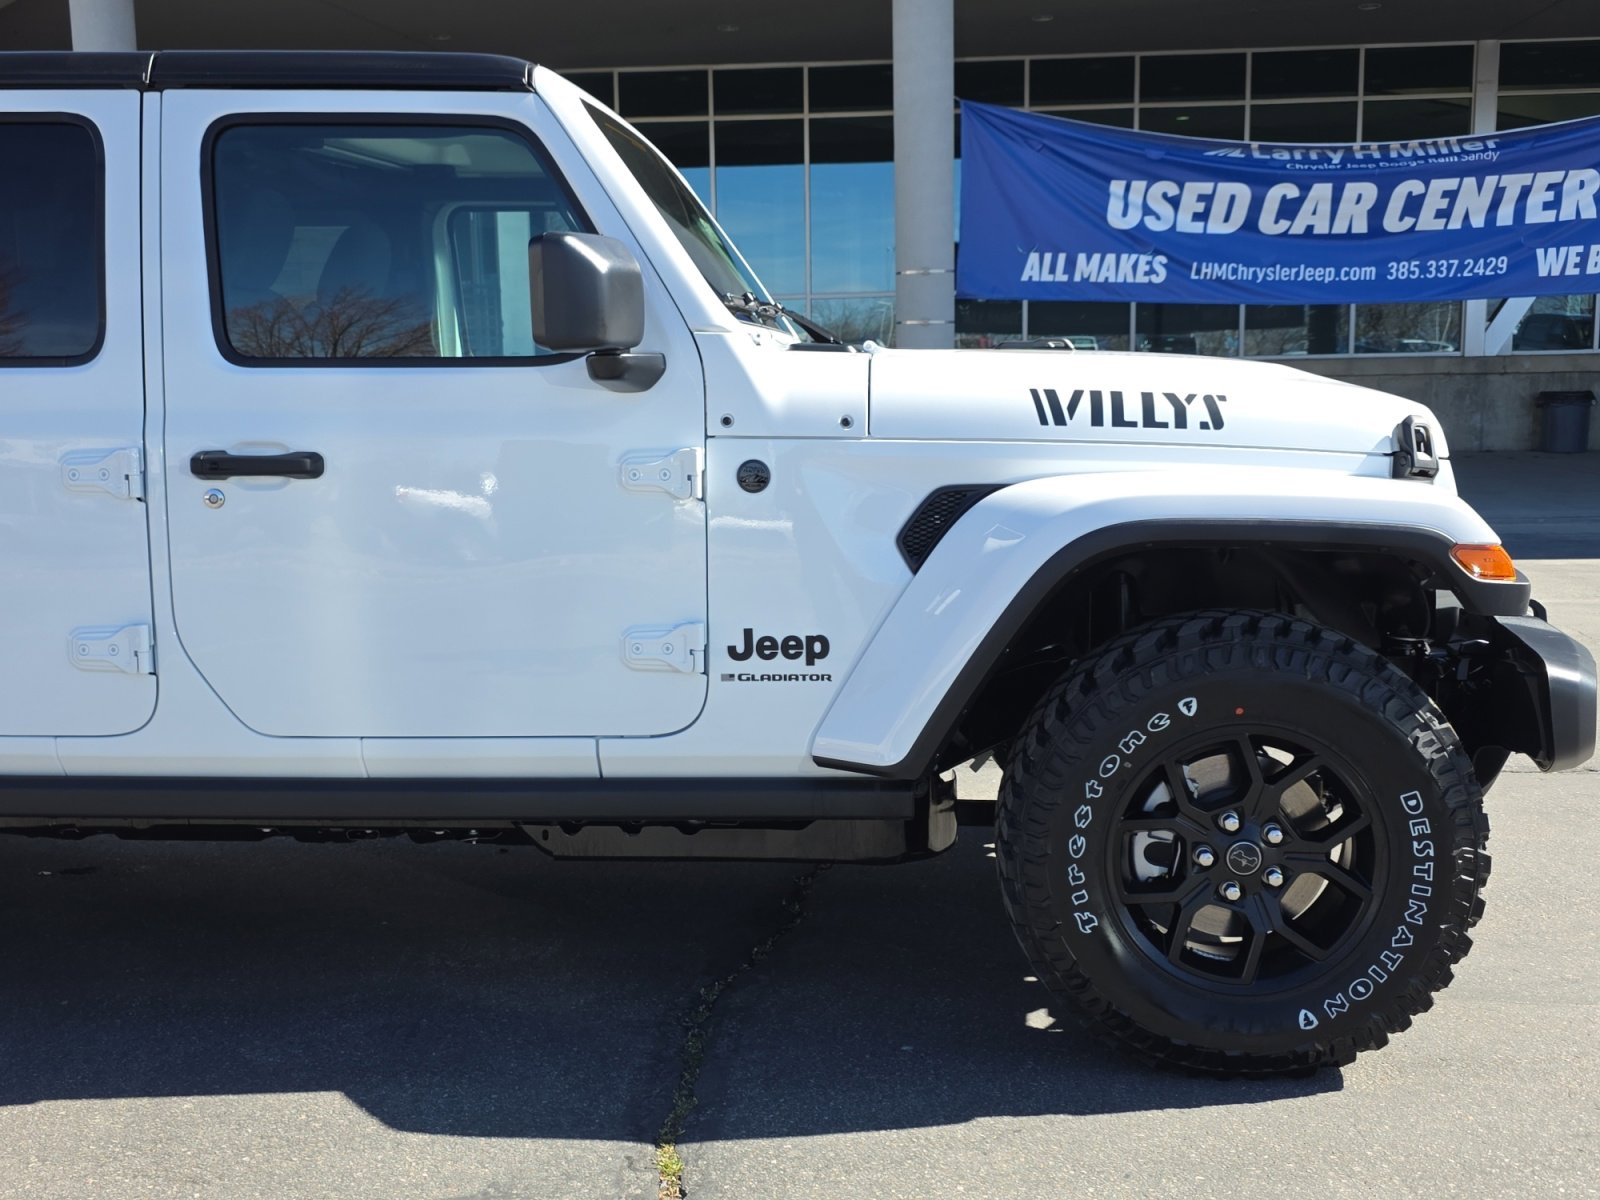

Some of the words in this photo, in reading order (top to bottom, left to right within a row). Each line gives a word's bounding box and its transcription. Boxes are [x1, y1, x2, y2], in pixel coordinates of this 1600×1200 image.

[1251, 144, 1345, 164] Larry
[1353, 143, 1382, 160] H
[1388, 139, 1500, 158] Miller
[1286, 162, 1342, 170] Chrysler
[1460, 150, 1500, 162] Sandy
[1107, 179, 1251, 234] USED
[1258, 182, 1379, 235] CAR
[1383, 168, 1600, 233] CENTER
[1021, 252, 1068, 282] ALL
[1074, 253, 1168, 284] MAKES
[1190, 261, 1377, 284] LHMChryslerJeep.com
[1386, 256, 1508, 280] 385.337.2429
[1536, 245, 1584, 277] WE
[1029, 388, 1227, 430] WILLYS
[727, 628, 830, 666] Jeep
[737, 673, 832, 682] GLADIATOR
[1068, 713, 1170, 933] Firestone
[1324, 790, 1434, 1019] DESTINATION
